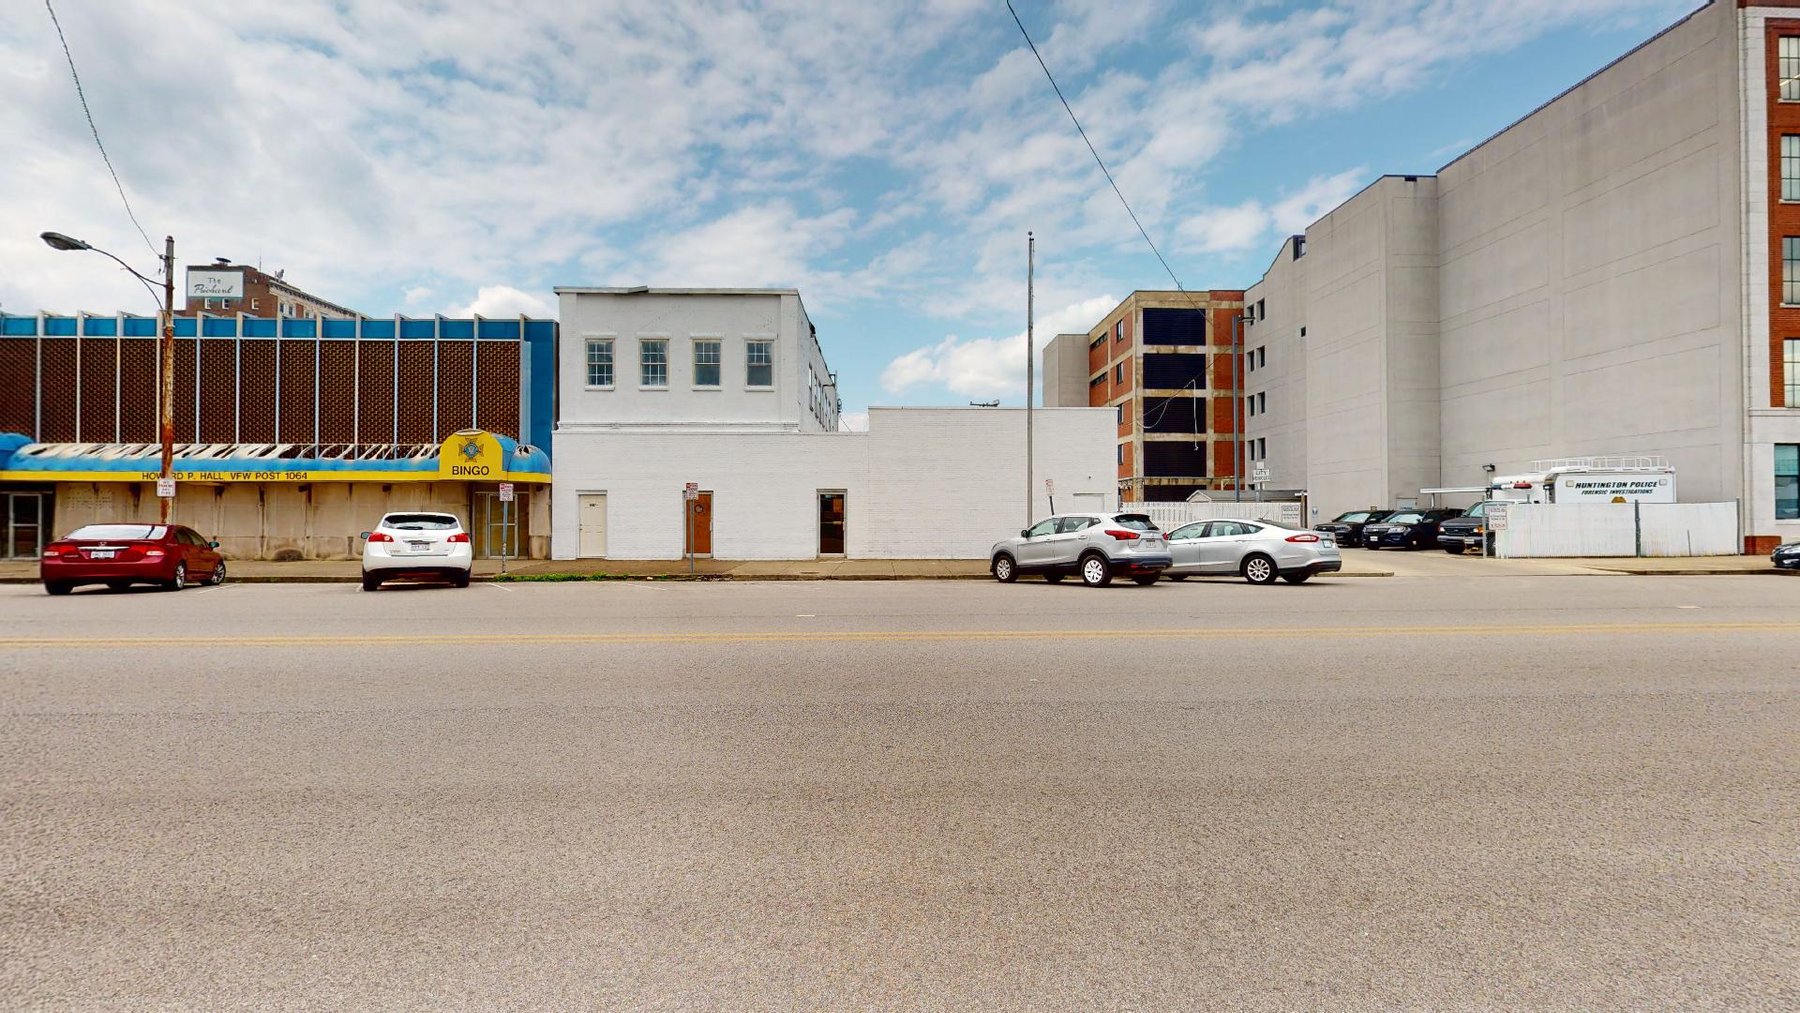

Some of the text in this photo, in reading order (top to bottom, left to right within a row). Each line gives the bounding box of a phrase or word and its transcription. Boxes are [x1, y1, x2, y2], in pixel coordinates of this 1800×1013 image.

[452, 465, 490, 476] BINGO
[142, 472, 308, 480] HOWRD P. HALL VFW POST 1064
